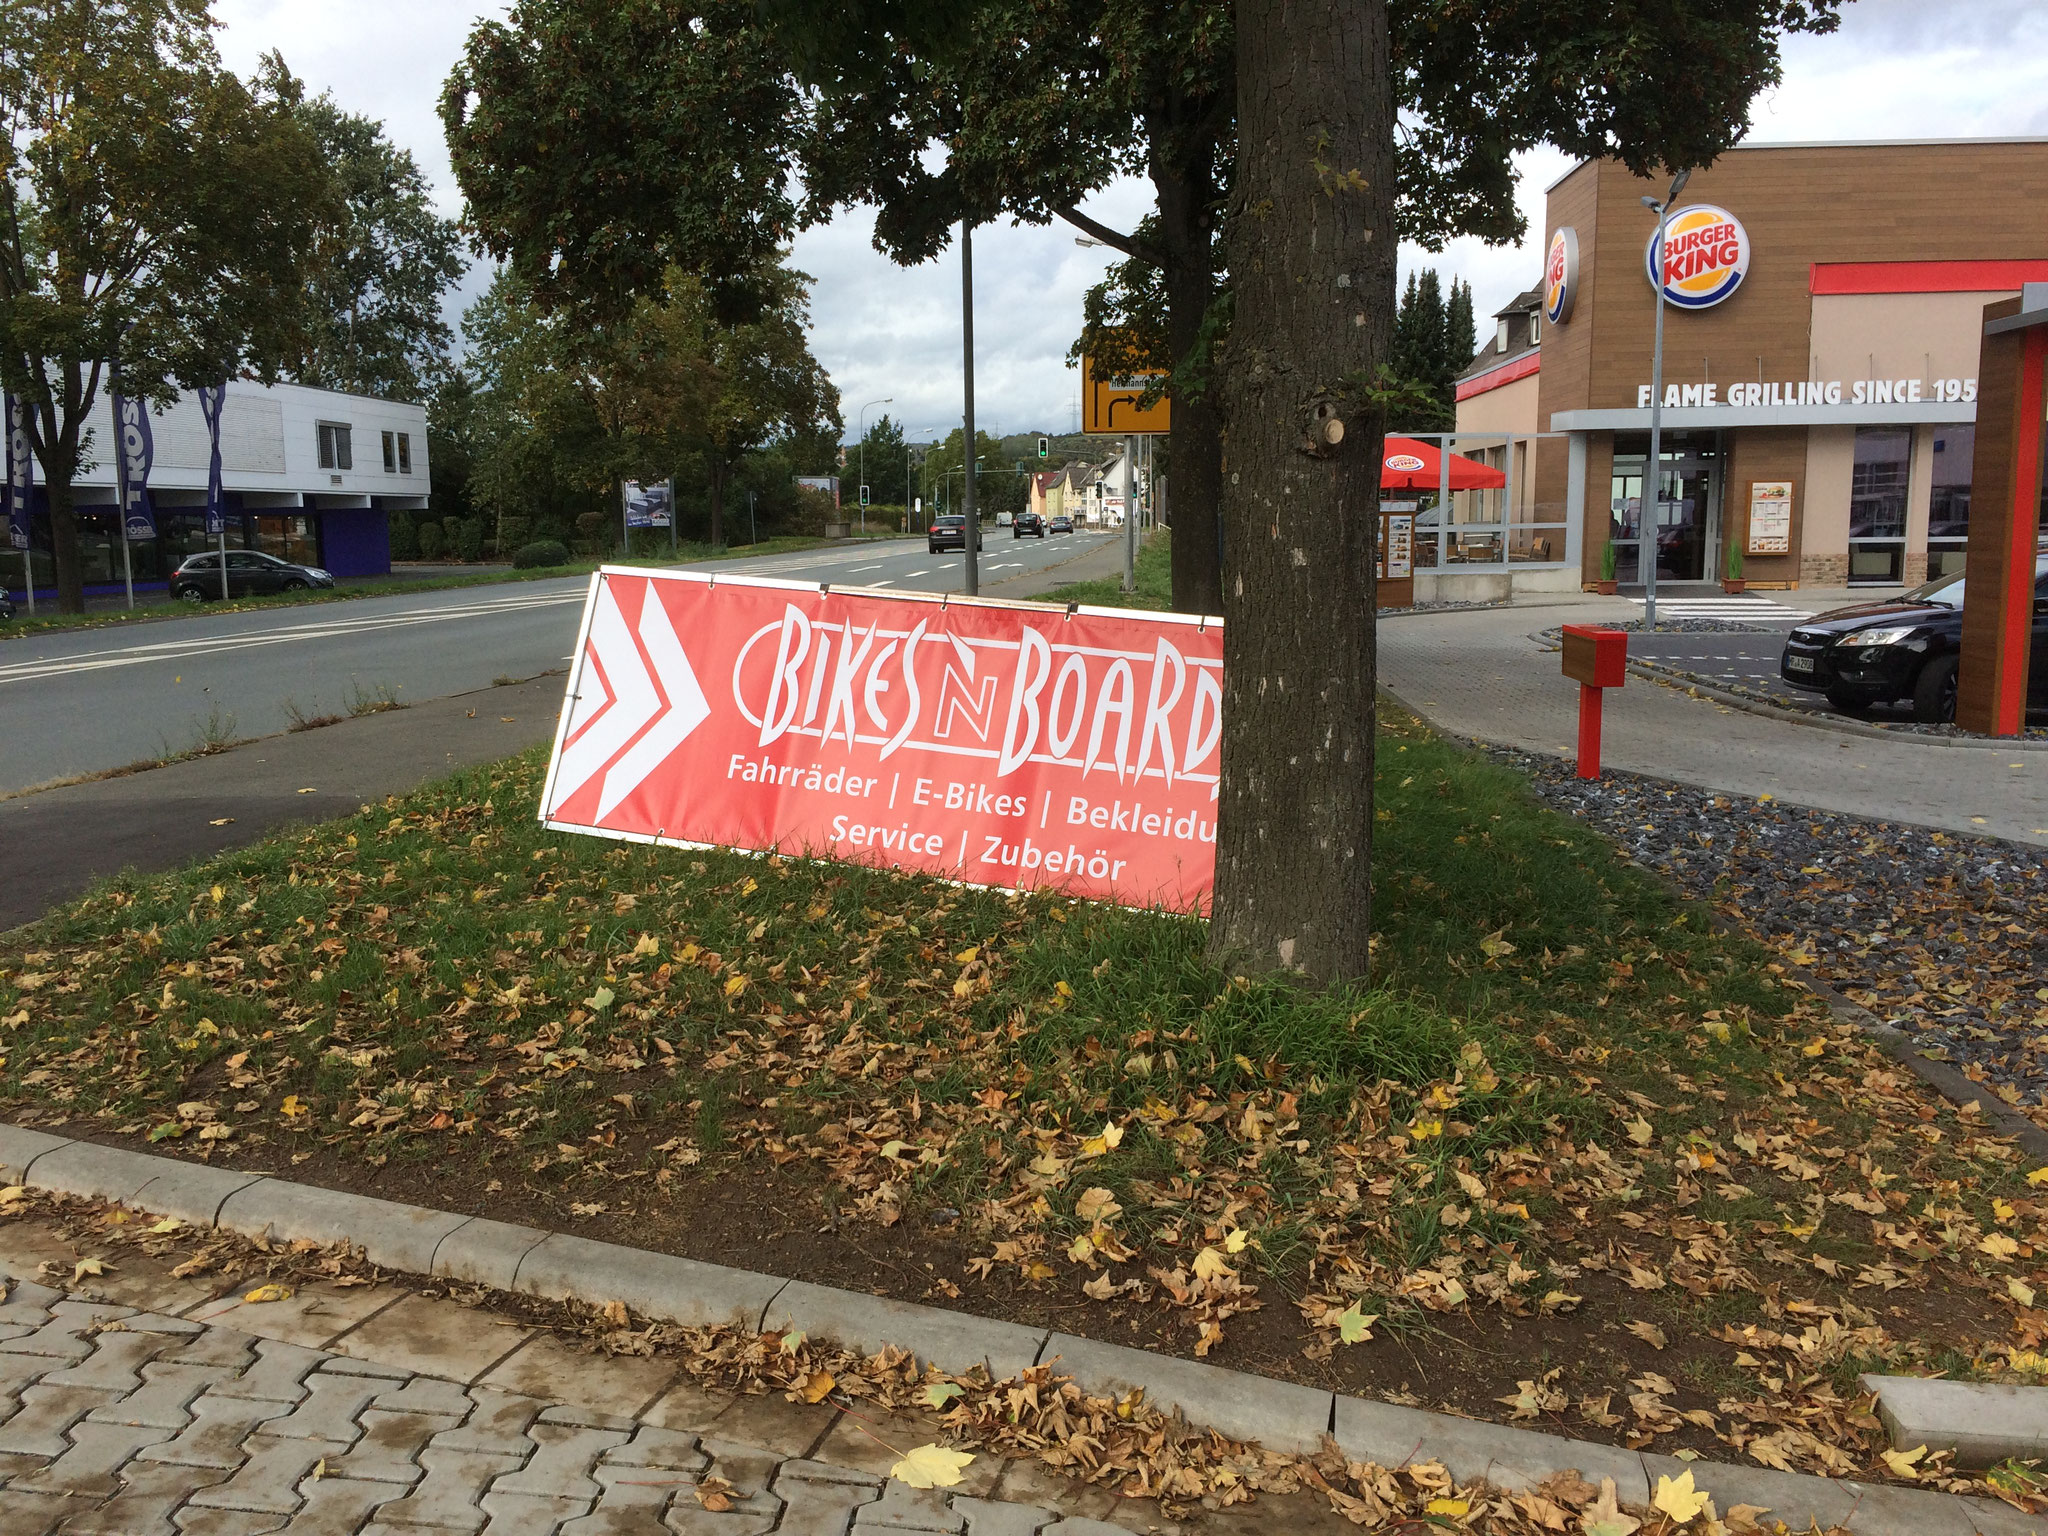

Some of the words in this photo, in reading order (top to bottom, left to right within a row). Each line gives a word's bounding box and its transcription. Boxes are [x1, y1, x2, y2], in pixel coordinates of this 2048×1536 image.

[1663, 223, 1736, 260] BURGER
[1663, 240, 1739, 287] KING
[1637, 383, 1717, 408] FLAME
[1727, 381, 1841, 406] GRILLING
[1852, 379, 1921, 404] SINCE
[1932, 378, 1977, 402] 195
[757, 602, 928, 763] BIKES
[996, 624, 1222, 802] BOARD
[727, 753, 878, 798] Fahrräder
[912, 777, 1027, 818] E-Bikes
[828, 815, 944, 856] Service
[980, 835, 1127, 881] Zubehör
